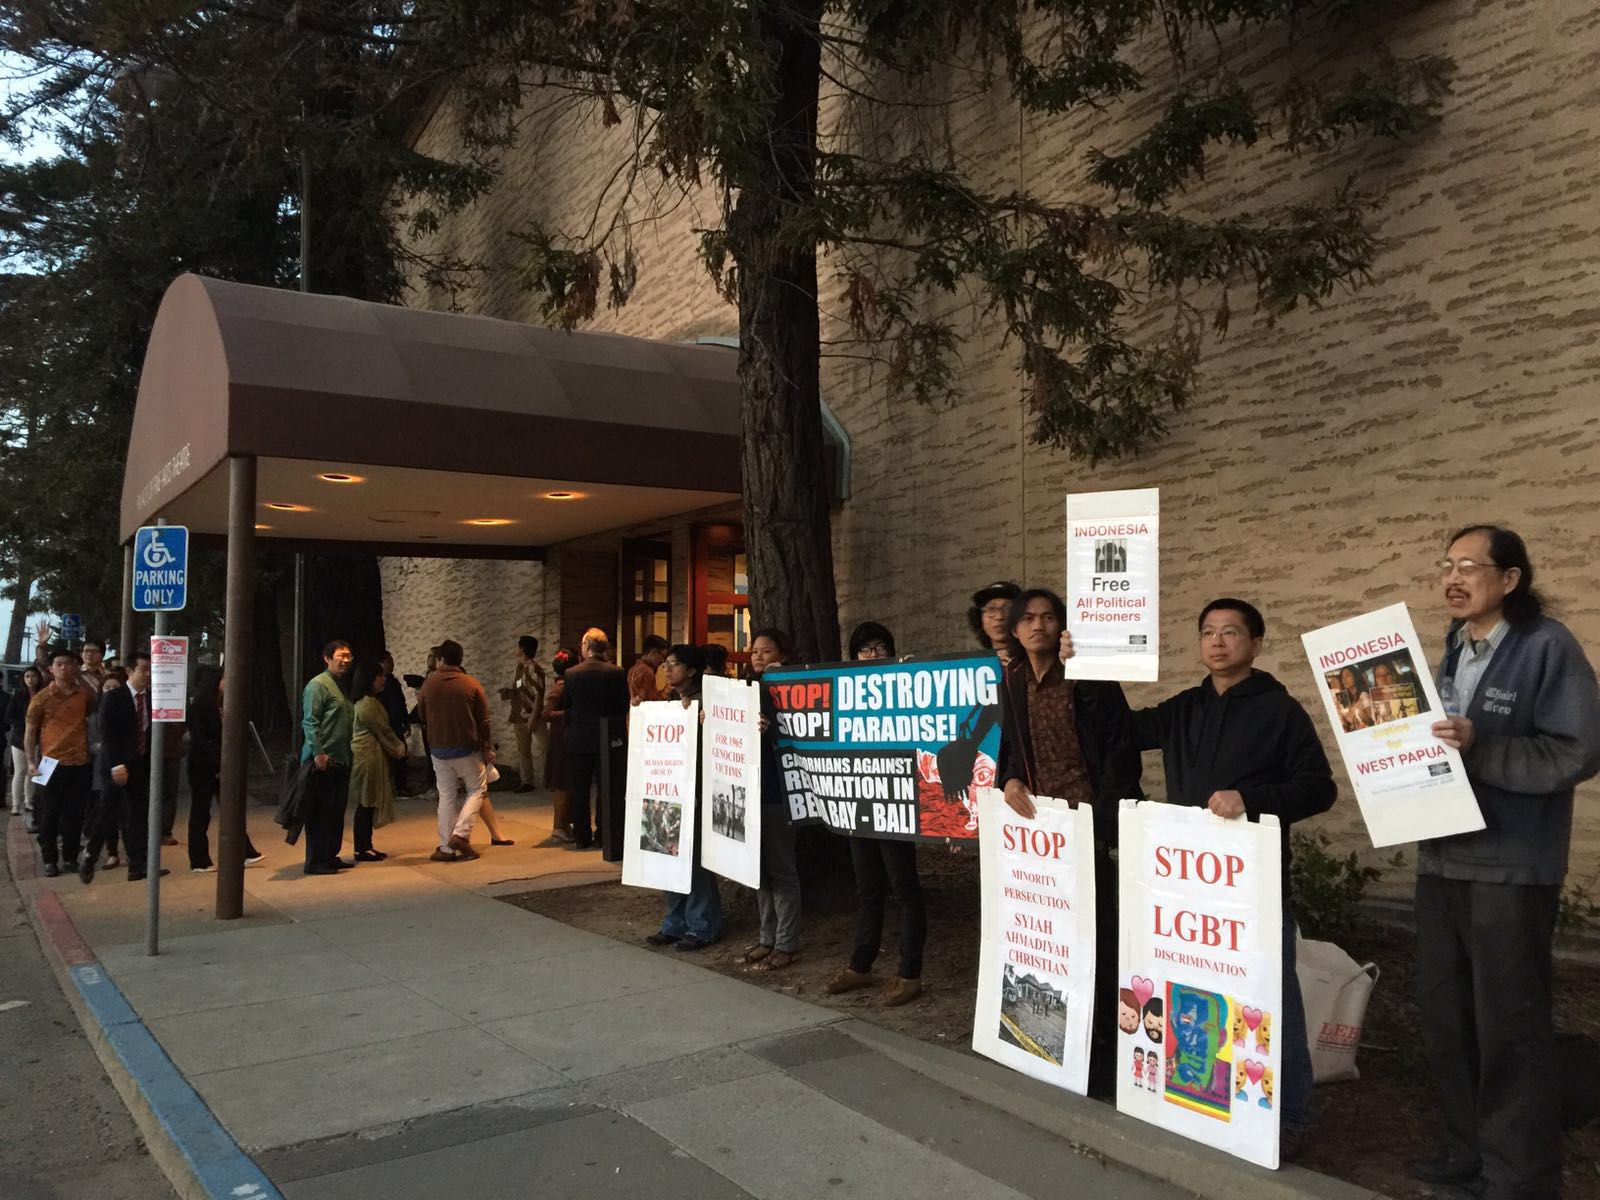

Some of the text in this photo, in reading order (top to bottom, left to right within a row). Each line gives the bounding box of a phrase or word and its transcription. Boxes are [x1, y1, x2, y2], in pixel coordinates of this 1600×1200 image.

[1074, 524, 1148, 538] INDONESIA
[135, 569, 185, 587] PARKING
[1092, 577, 1130, 592] Free
[143, 588, 175, 606] ONLY
[1076, 596, 1146, 609] All Political
[1081, 610, 1141, 623] Prisoners
[1318, 631, 1406, 669] INDONESIA
[768, 683, 831, 711] STOP!
[838, 665, 999, 712] DESTROYING
[711, 703, 747, 724] JUSTICE
[775, 711, 831, 738] STOP!
[646, 724, 685, 743] STOP
[714, 733, 728, 746] FOR
[838, 713, 958, 743] PARADISE!
[711, 747, 746, 765] GENOCIDE
[853, 757, 914, 775] AGAINST
[1355, 744, 1448, 776] WEST PAPUA
[714, 762, 742, 778] VICTIMS
[645, 782, 680, 797] PAPUA
[893, 776, 916, 801] IN
[827, 799, 858, 831] BAY
[872, 802, 917, 835] BALI
[1002, 823, 1067, 860] STOP
[1012, 868, 1057, 888] MINORITY
[1155, 845, 1245, 888] STOP
[1004, 886, 1071, 911] PERSECUTION
[1014, 912, 1053, 936] SYIAH
[1153, 904, 1246, 952] LGBT
[1004, 930, 1070, 959] AHMADIYAH
[1008, 948, 1069, 977] CHRISTIAN
[1154, 947, 1248, 978] DISCRIMINATION
